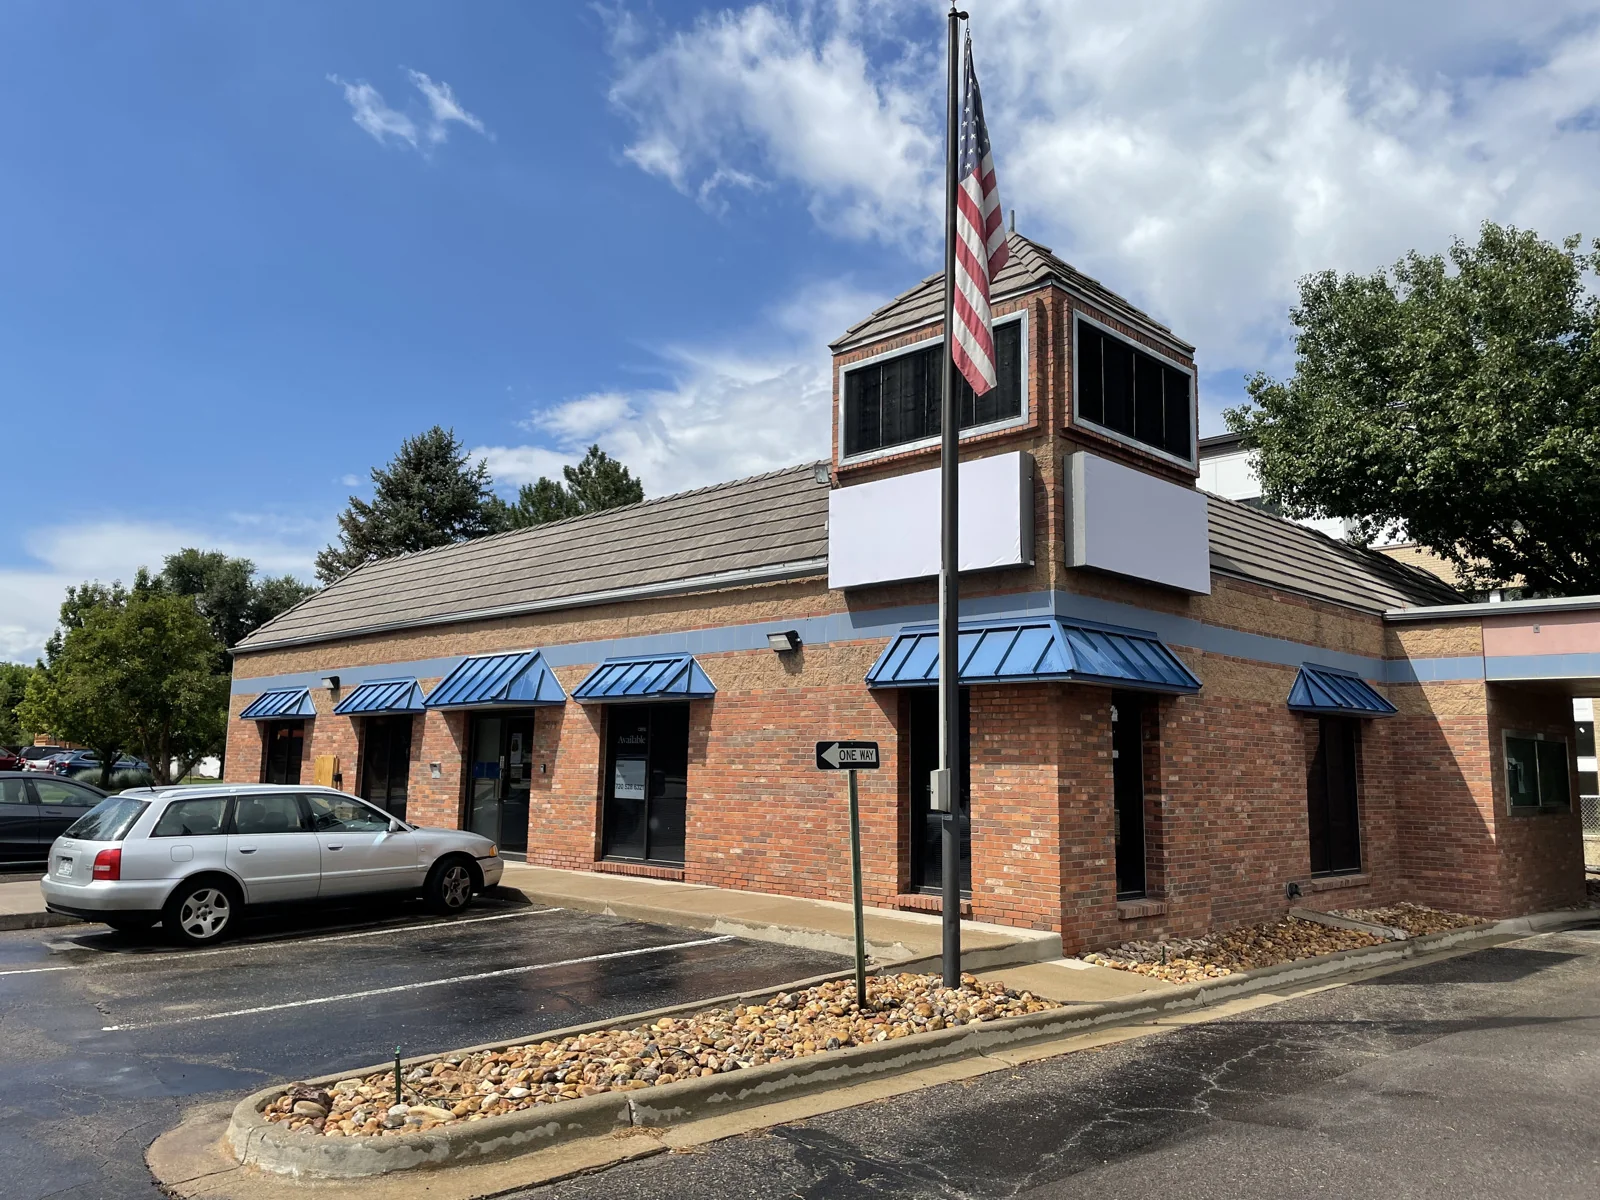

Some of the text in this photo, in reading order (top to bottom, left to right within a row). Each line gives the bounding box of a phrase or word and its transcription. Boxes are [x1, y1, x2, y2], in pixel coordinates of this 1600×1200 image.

[617, 735, 646, 744] Available
[839, 749, 874, 761] ONE WAY
